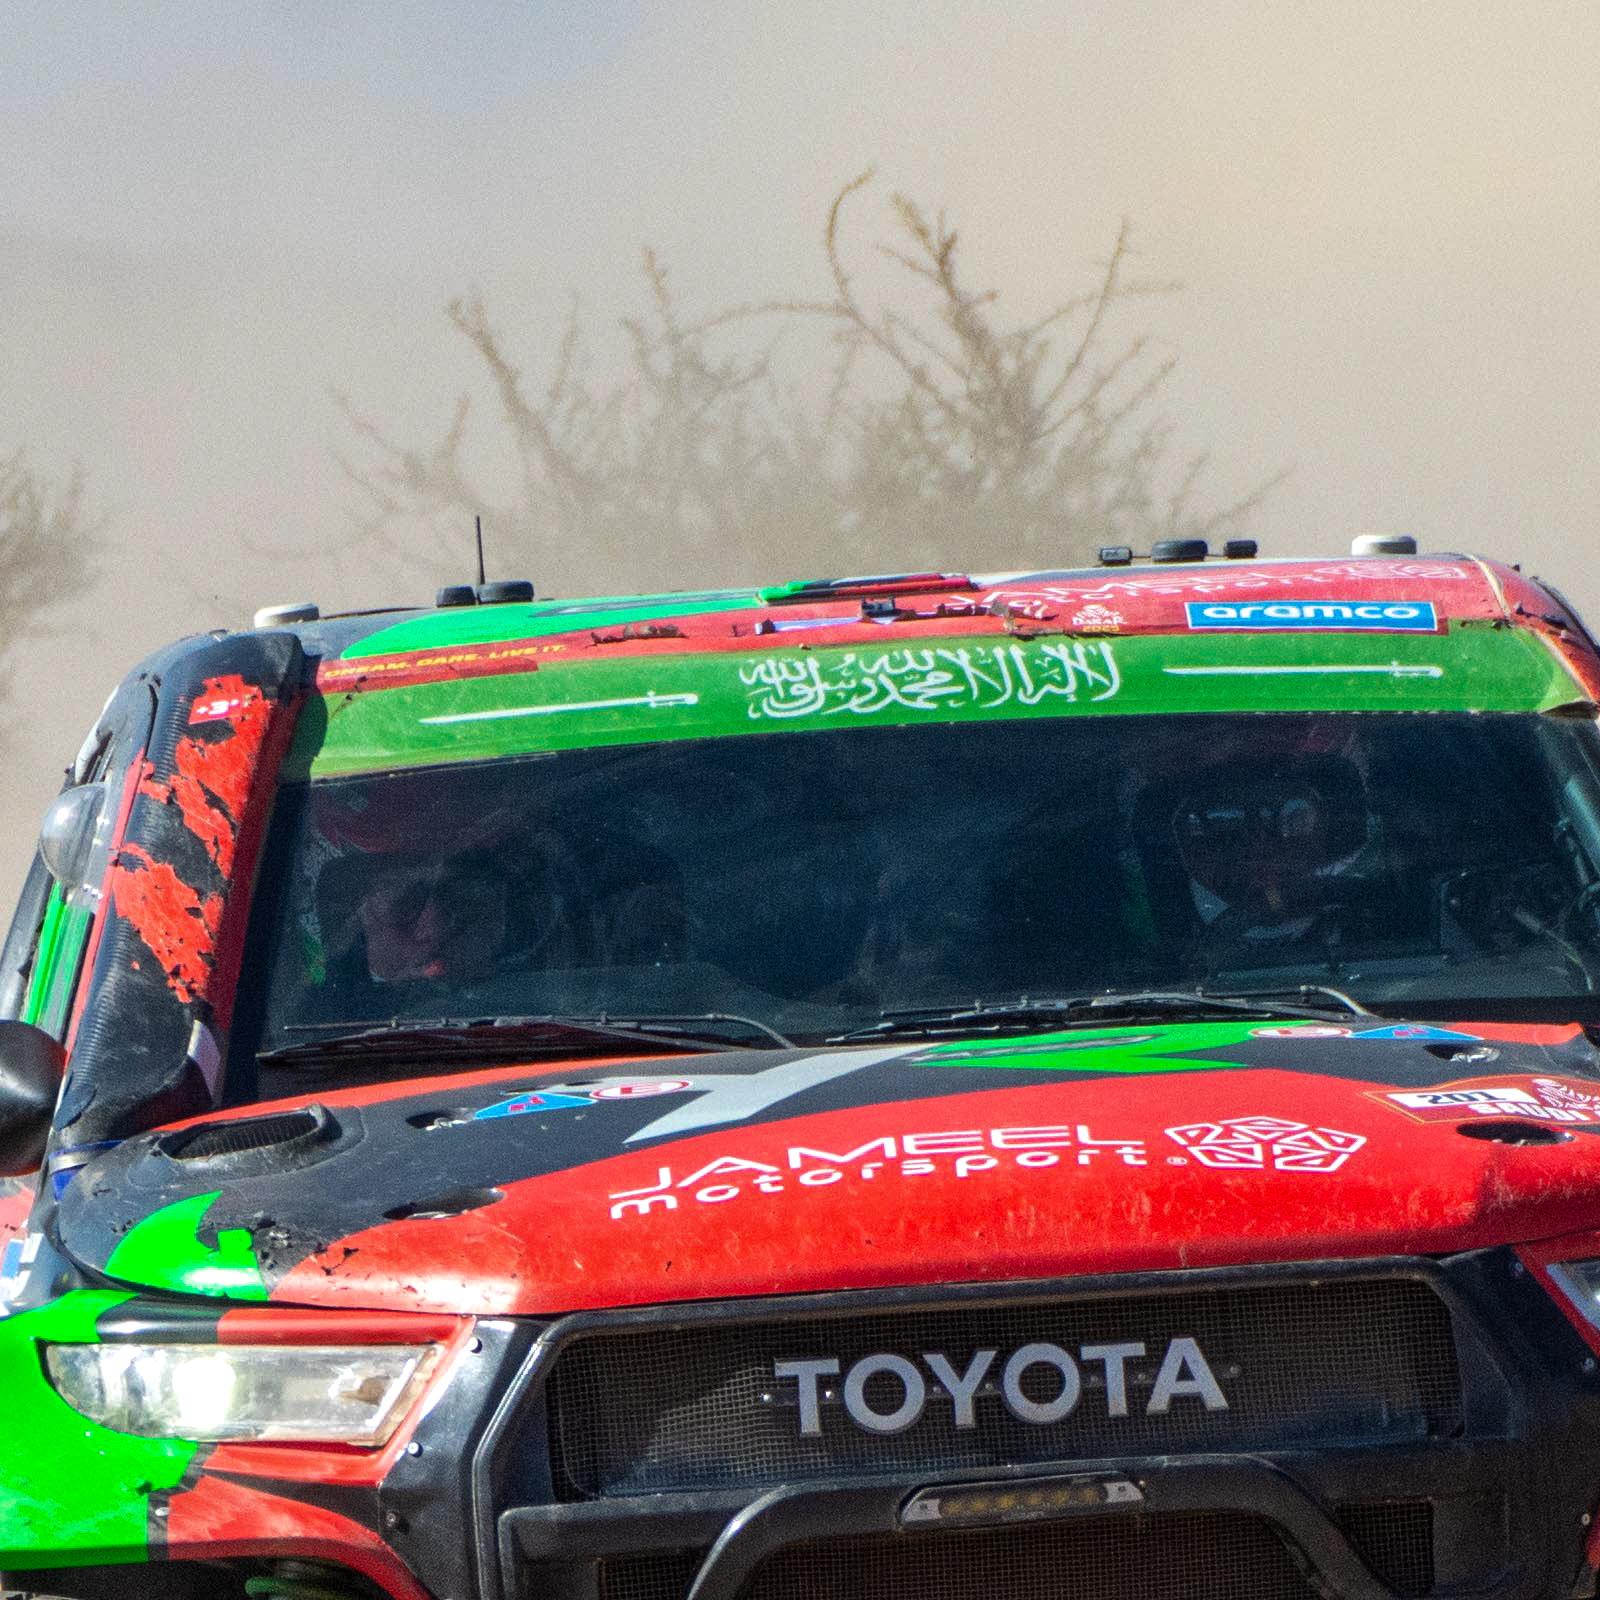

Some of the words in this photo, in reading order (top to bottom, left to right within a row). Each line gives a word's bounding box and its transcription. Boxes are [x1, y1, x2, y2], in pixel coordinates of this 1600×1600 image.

[1202, 602, 1420, 620] aramco
[488, 646, 538, 660] LIVE
[1417, 1091, 1506, 1105] 201
[1467, 1102, 1590, 1121] SAUDI
[608, 1124, 1145, 1200] JAMEEL
[609, 1144, 1148, 1220] motorsport
[773, 1336, 1230, 1438] TOYOTA
